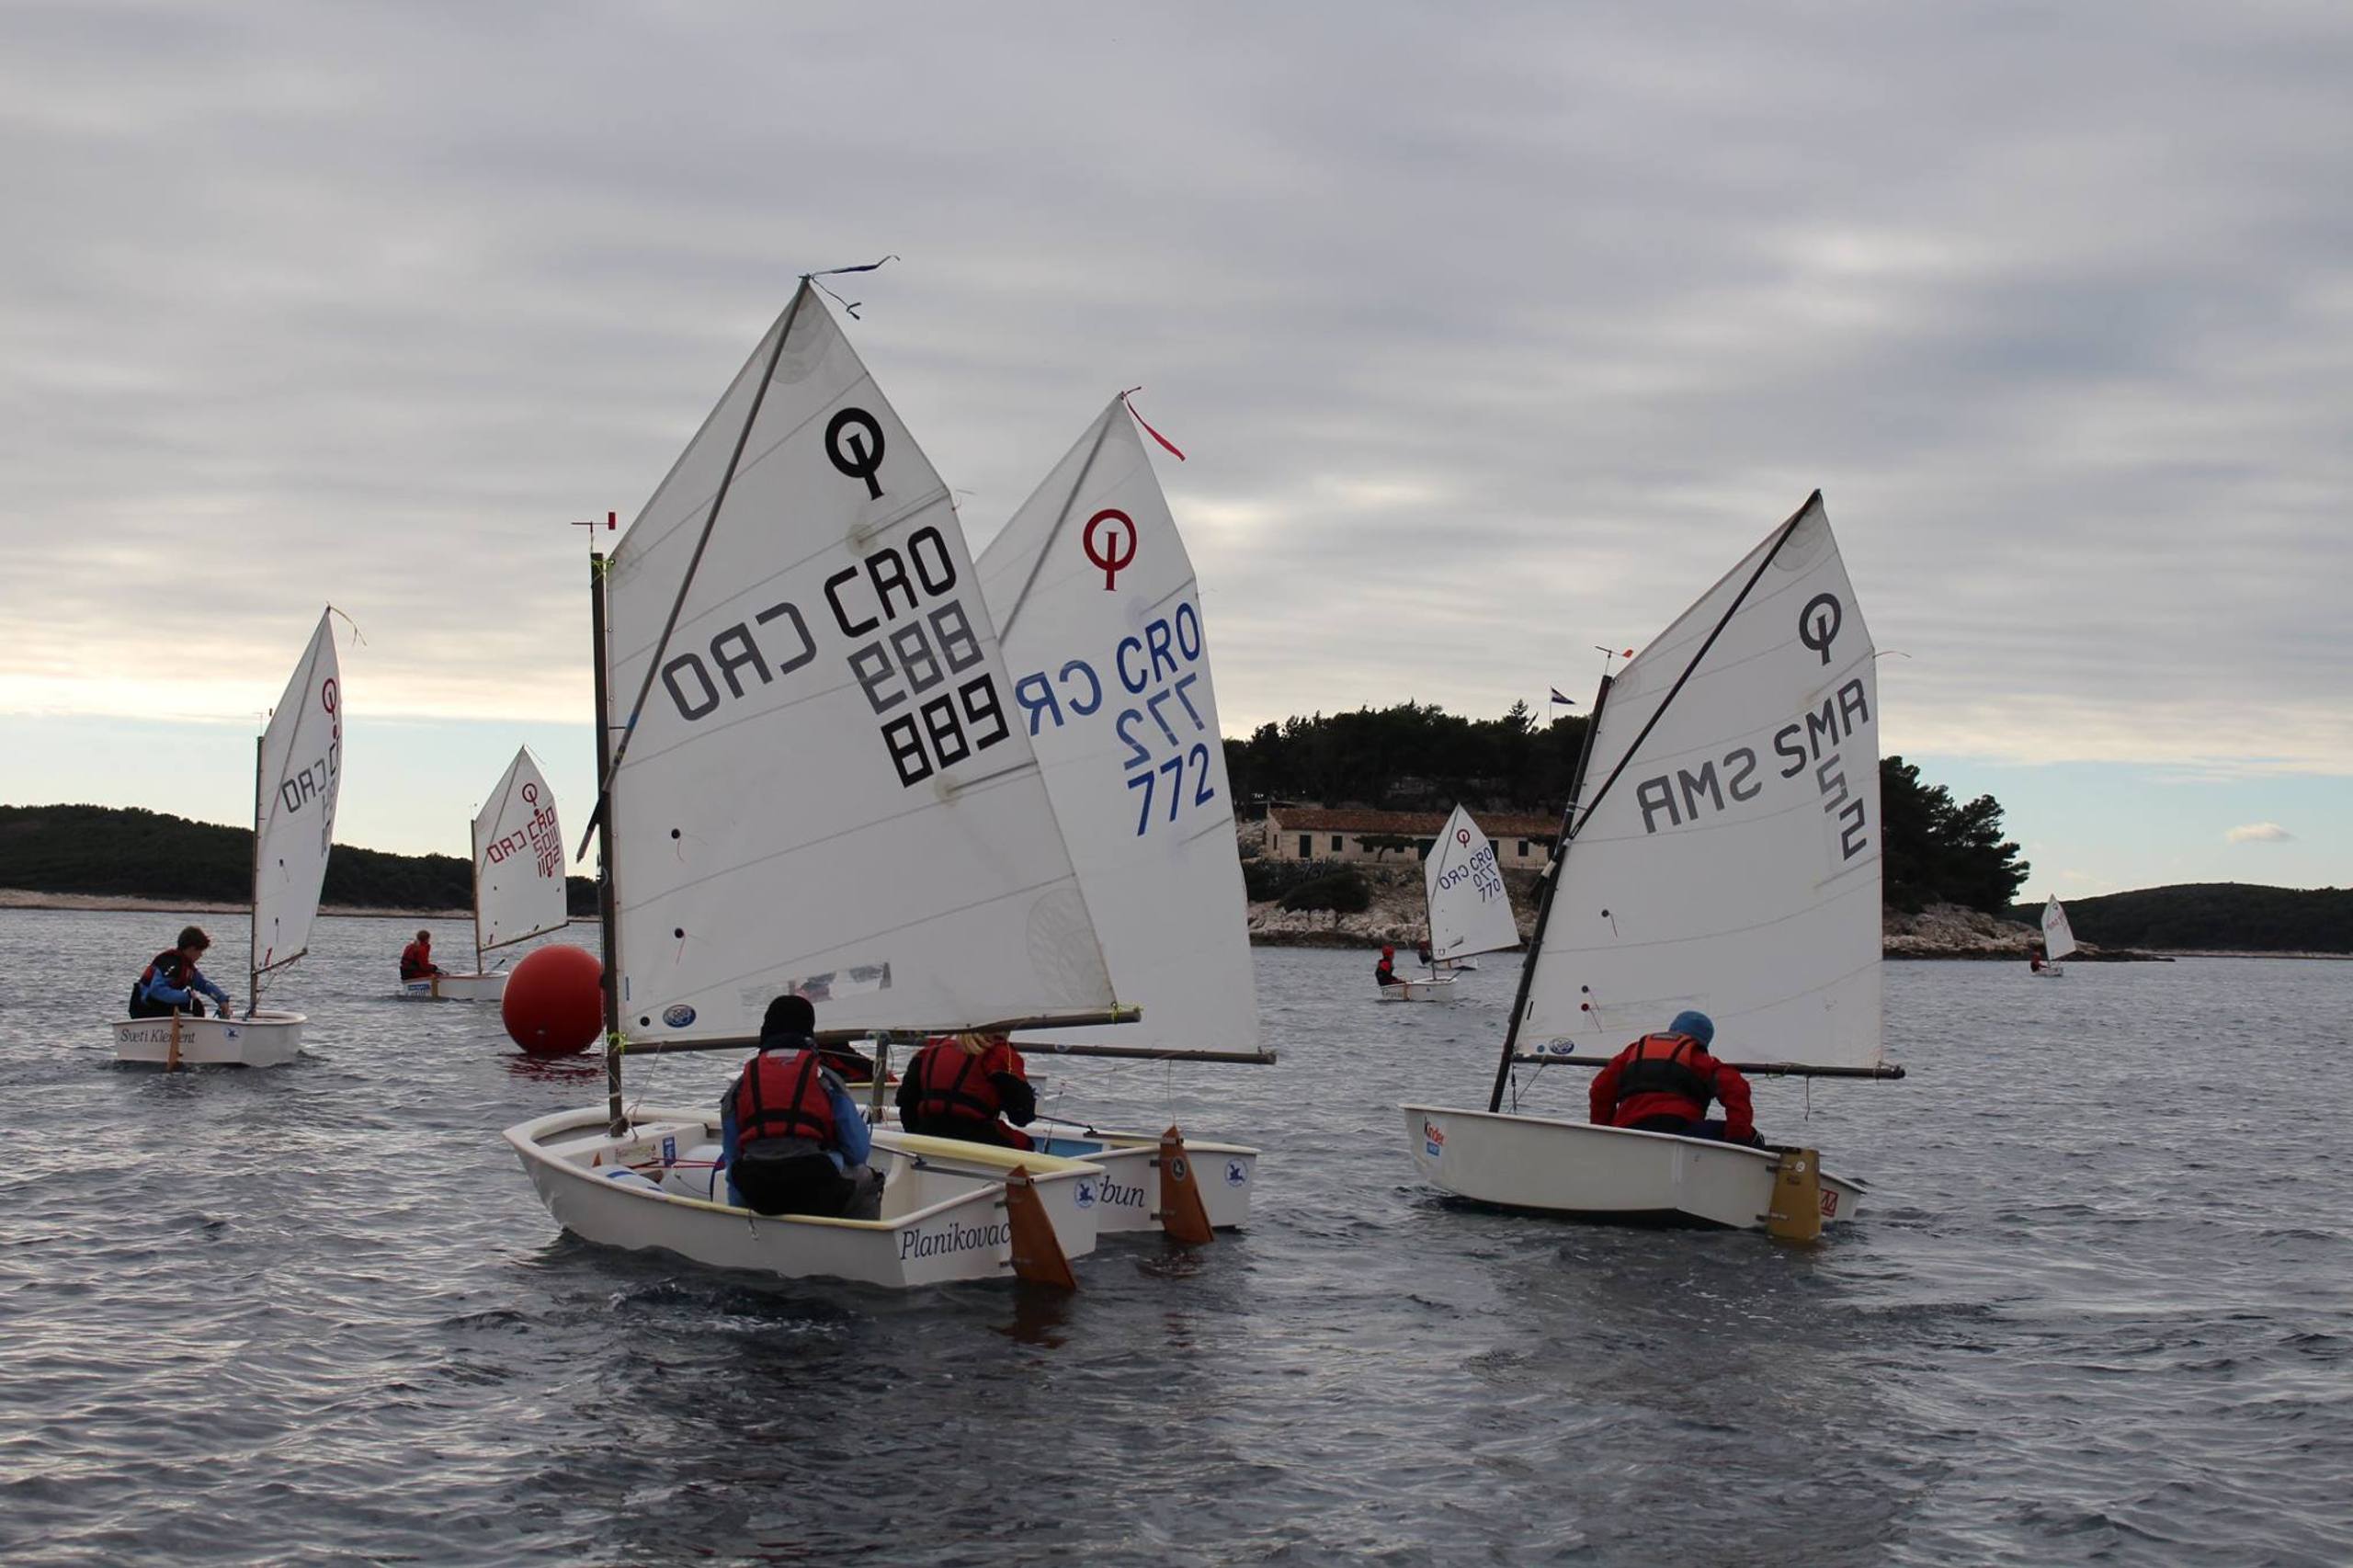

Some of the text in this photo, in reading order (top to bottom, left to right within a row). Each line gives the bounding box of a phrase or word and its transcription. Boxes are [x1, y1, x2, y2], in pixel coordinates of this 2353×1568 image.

[824, 526, 956, 638] CRO
[1117, 602, 1200, 694] CRO
[881, 673, 1010, 789] 889
[1127, 743, 1214, 837] 772
[1469, 846, 1493, 873] CRO
[1478, 878, 1501, 903] 770
[150, 1028, 196, 1044] Kleent
[1099, 1175, 1145, 1208] bun
